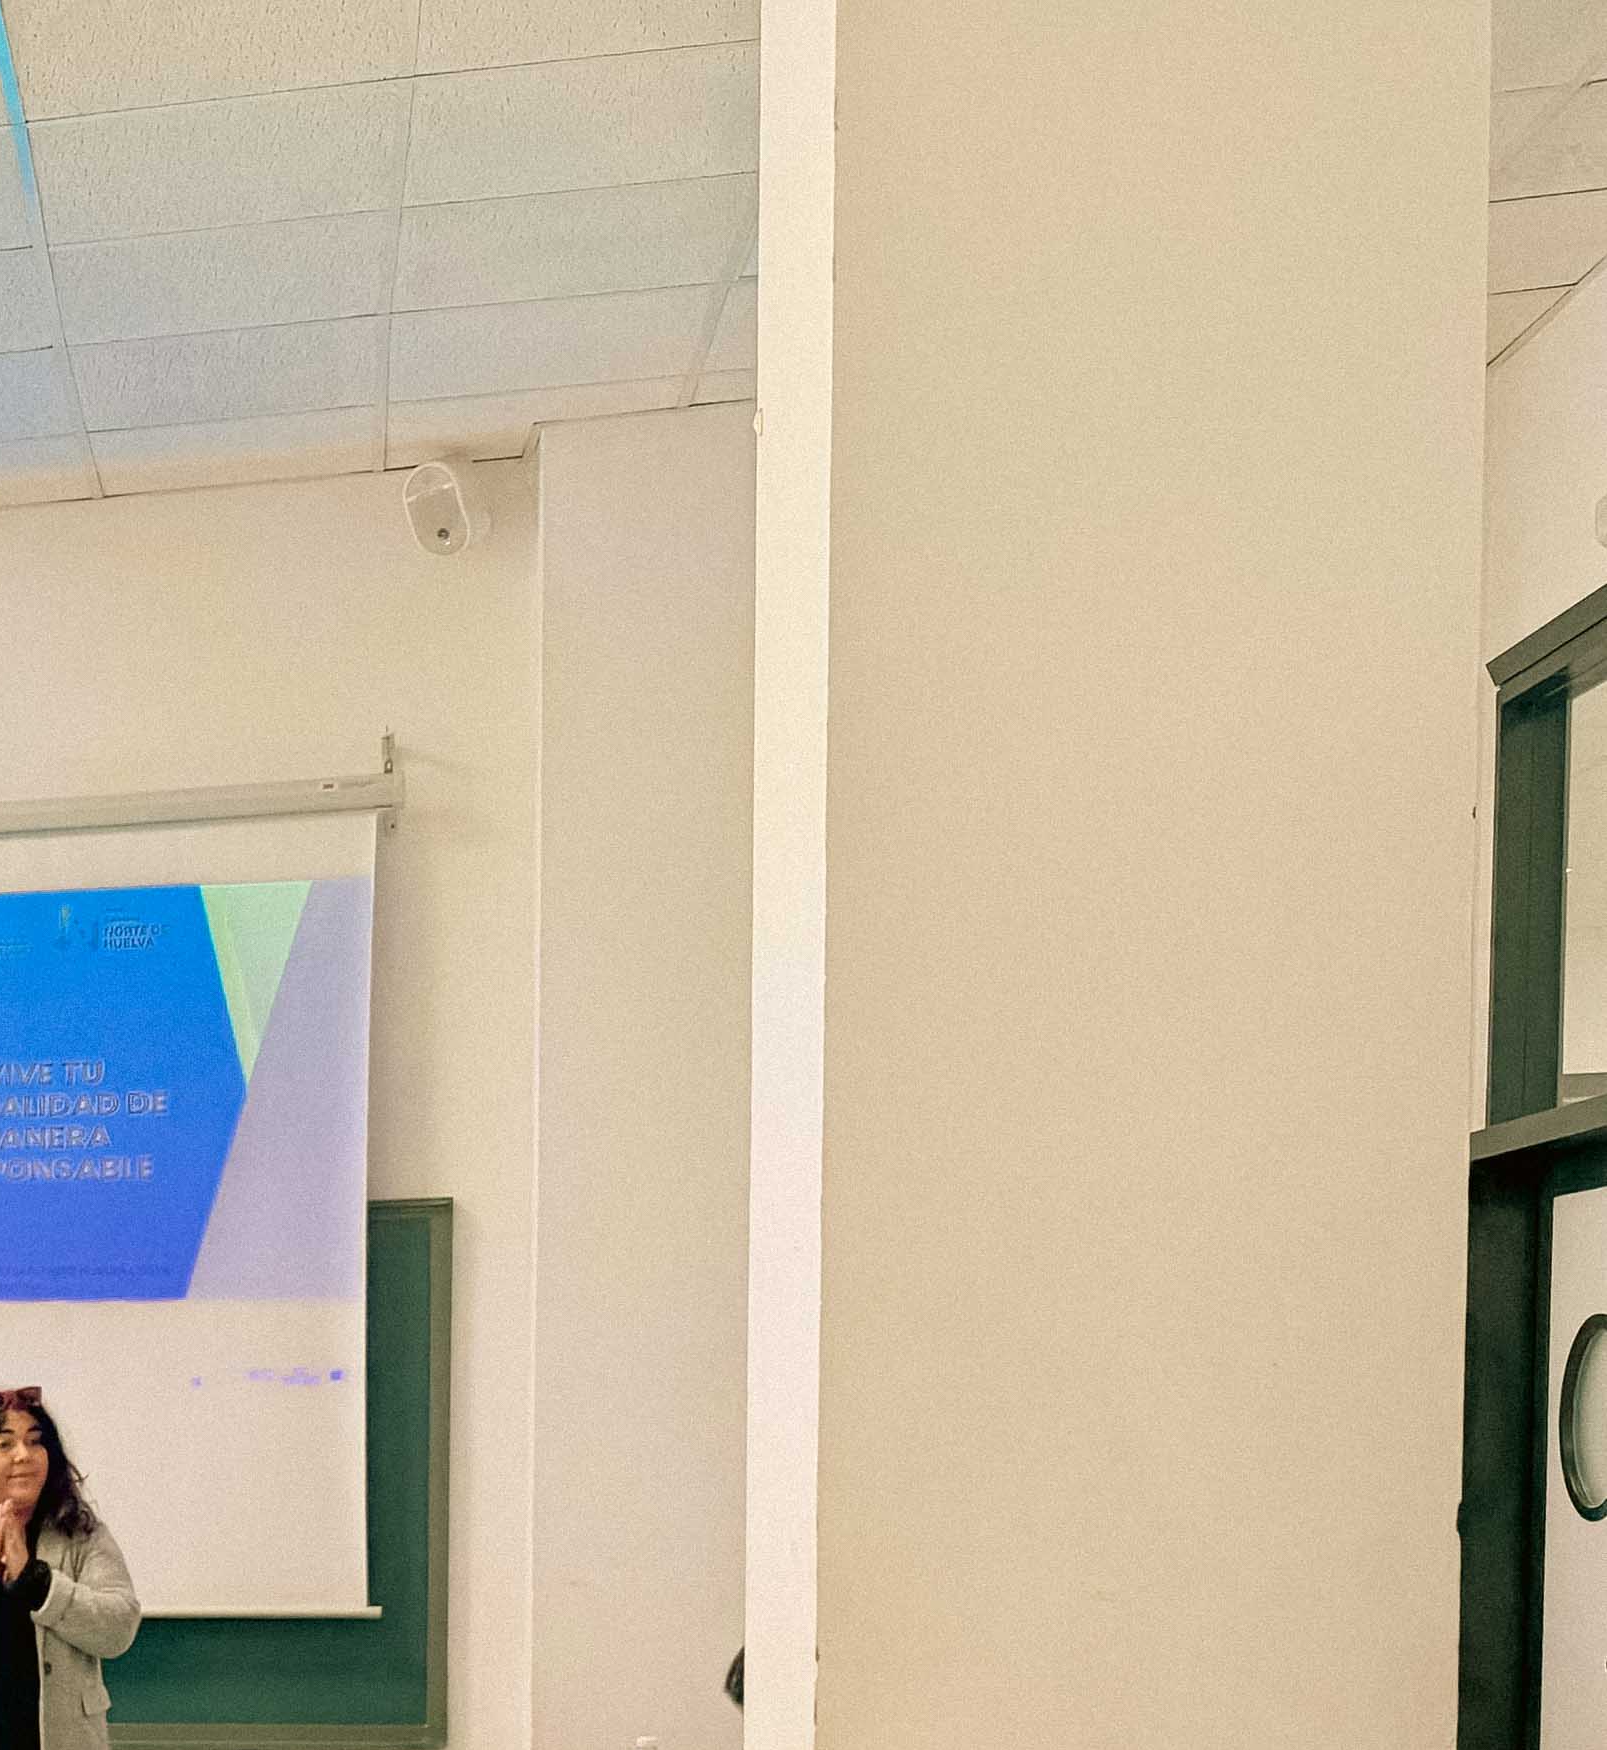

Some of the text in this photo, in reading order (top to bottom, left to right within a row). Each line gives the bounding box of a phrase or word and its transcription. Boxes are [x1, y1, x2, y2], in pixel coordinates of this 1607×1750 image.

[103, 936, 155, 949] HUELVA
[63, 1060, 105, 1085] TU
[127, 1091, 169, 1115] DE
